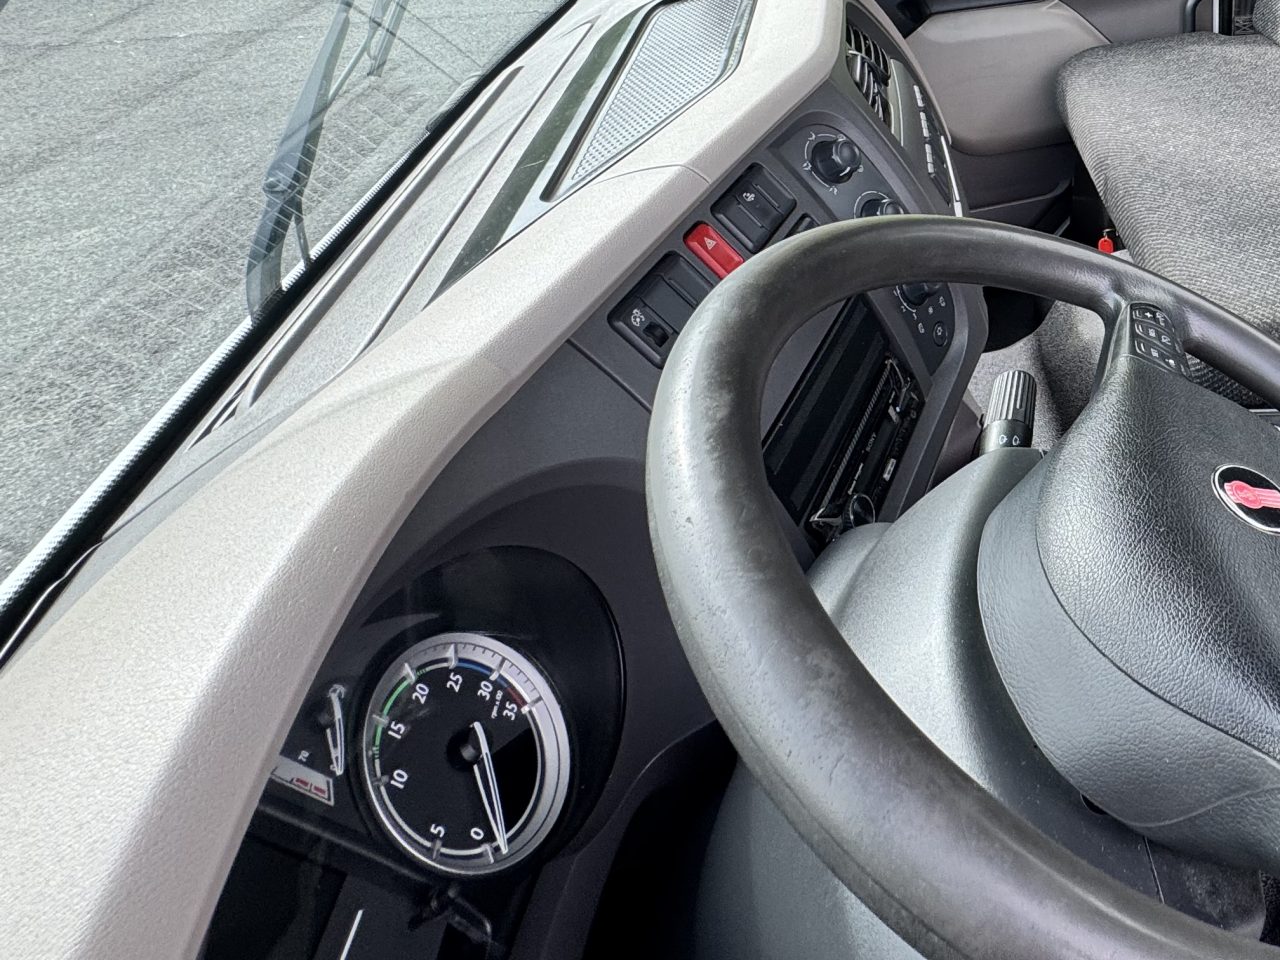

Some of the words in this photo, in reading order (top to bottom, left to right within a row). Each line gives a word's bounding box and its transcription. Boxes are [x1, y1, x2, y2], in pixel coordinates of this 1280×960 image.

[865, 431, 877, 452] SONY
[446, 672, 463, 693] 25
[477, 681, 493, 701] 30
[412, 683, 430, 704] 20
[502, 701, 518, 721] 35
[387, 721, 405, 739] 15
[390, 769, 408, 789] 10
[430, 823, 445, 838] 5
[470, 827, 484, 840] 0
